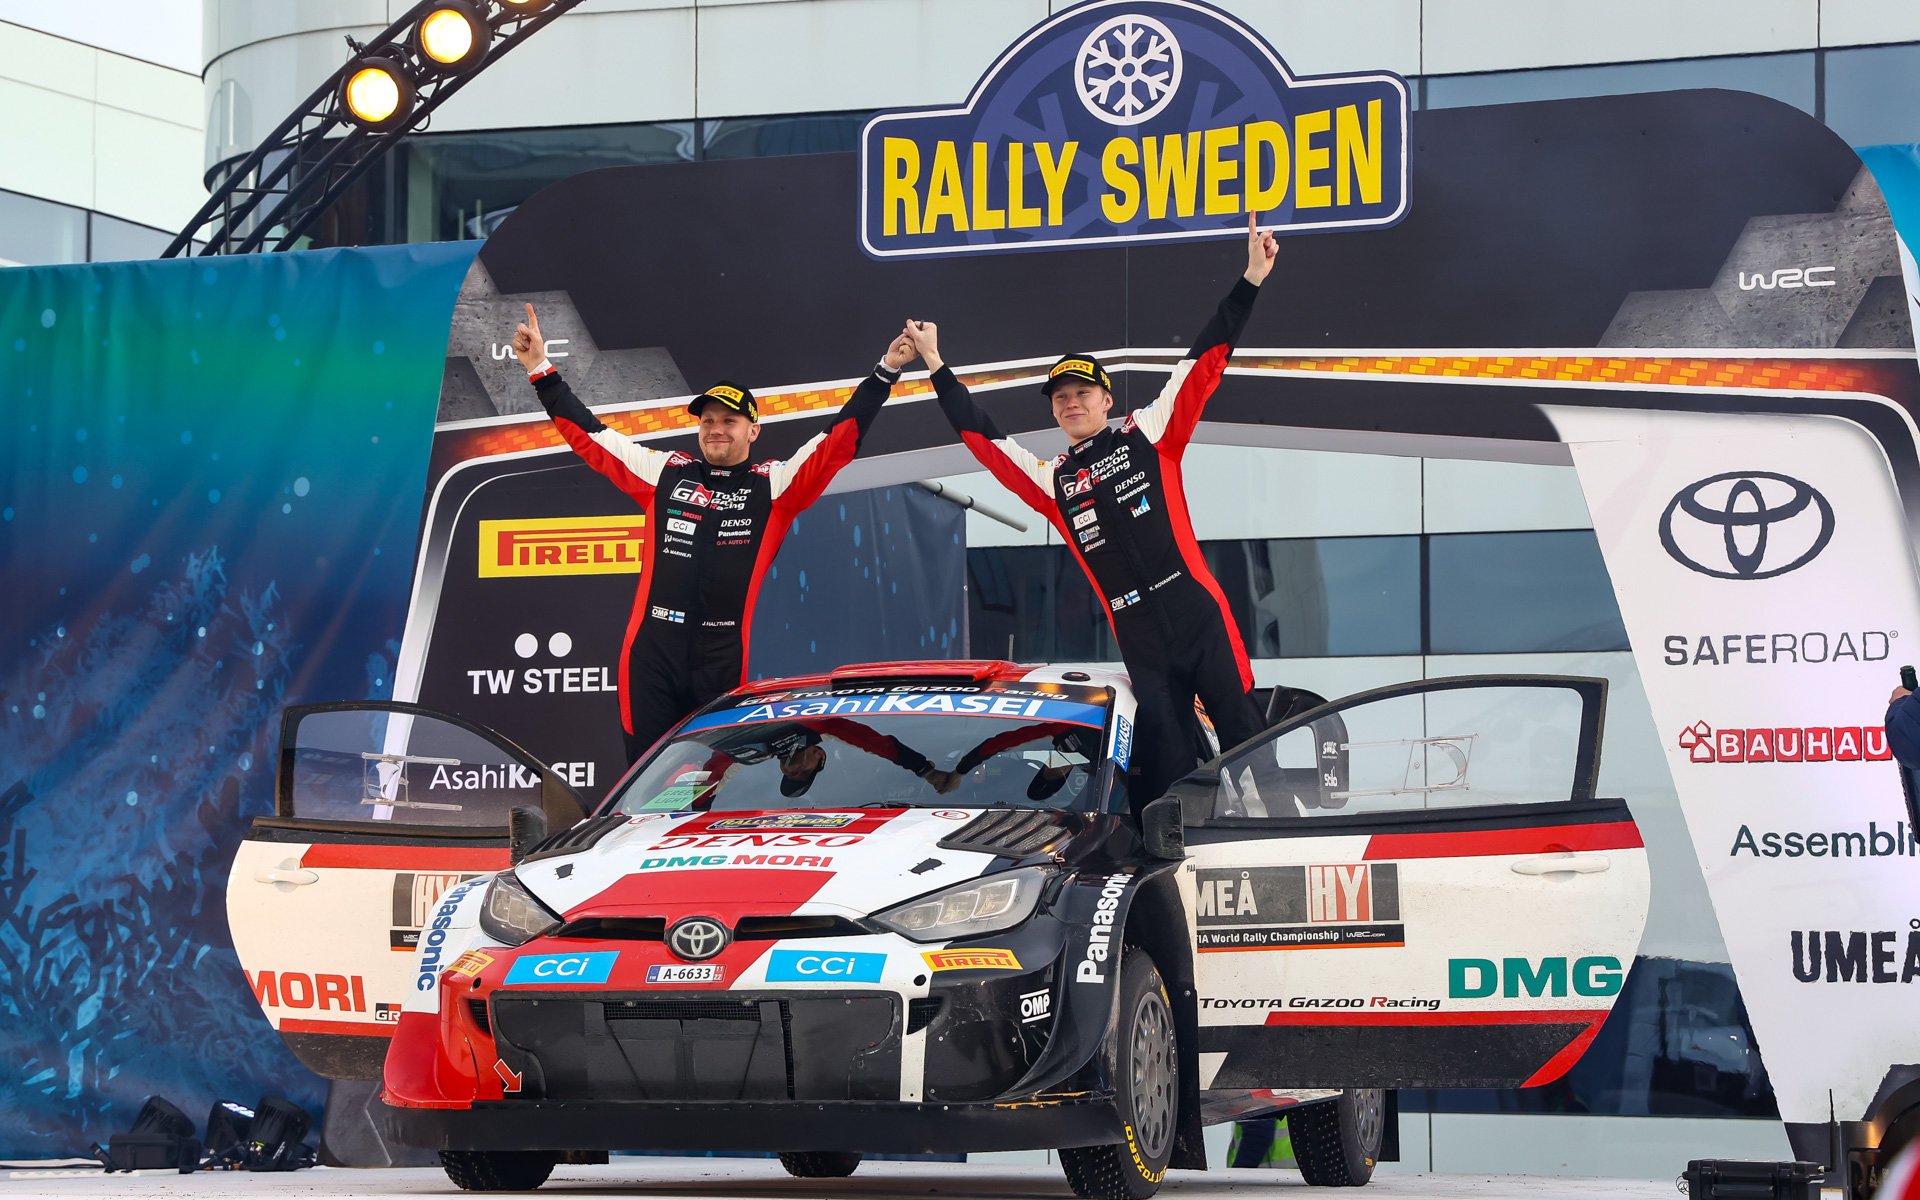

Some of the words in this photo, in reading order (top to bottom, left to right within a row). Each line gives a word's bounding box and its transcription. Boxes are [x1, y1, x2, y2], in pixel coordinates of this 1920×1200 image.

[883, 137, 1078, 236] RALLY
[1101, 99, 1382, 224] SWEDEN
[1739, 266, 1836, 290] WRC
[492, 339, 569, 360] WC
[1091, 453, 1128, 478] GAZOO
[1092, 460, 1130, 485] Racing
[1064, 477, 1091, 497] GR
[1115, 471, 1145, 493] DENSO
[1117, 482, 1151, 504] Panasonic
[673, 487, 708, 505] GR
[718, 529, 751, 537] Panasonic
[721, 518, 752, 527] DENSO
[652, 607, 669, 618] OMP
[467, 669, 515, 695] TW
[523, 666, 618, 693] STEEL
[792, 687, 885, 699] TOYOTA
[985, 687, 1069, 700] Racing
[737, 694, 1046, 722] AsahiKASEI
[647, 835, 865, 851] DENSO
[1310, 865, 1366, 921] HY
[417, 880, 489, 991] Panasonic
[1076, 873, 1134, 984] Panasonic
[1211, 933, 1240, 943] World
[1243, 932, 1267, 944] Rally
[1270, 929, 1339, 943] Championship
[930, 951, 1013, 967] PIRELLI
[663, 968, 711, 980] A-6633
[1448, 956, 1623, 999] DMG
[244, 969, 366, 1013] MORI
[1020, 994, 1050, 1017] OMP
[1202, 998, 1283, 1009] TOYOTA
[1288, 997, 1366, 1008] GAZOO
[1370, 997, 1440, 1011] Racing
[376, 1010, 401, 1021] GR
